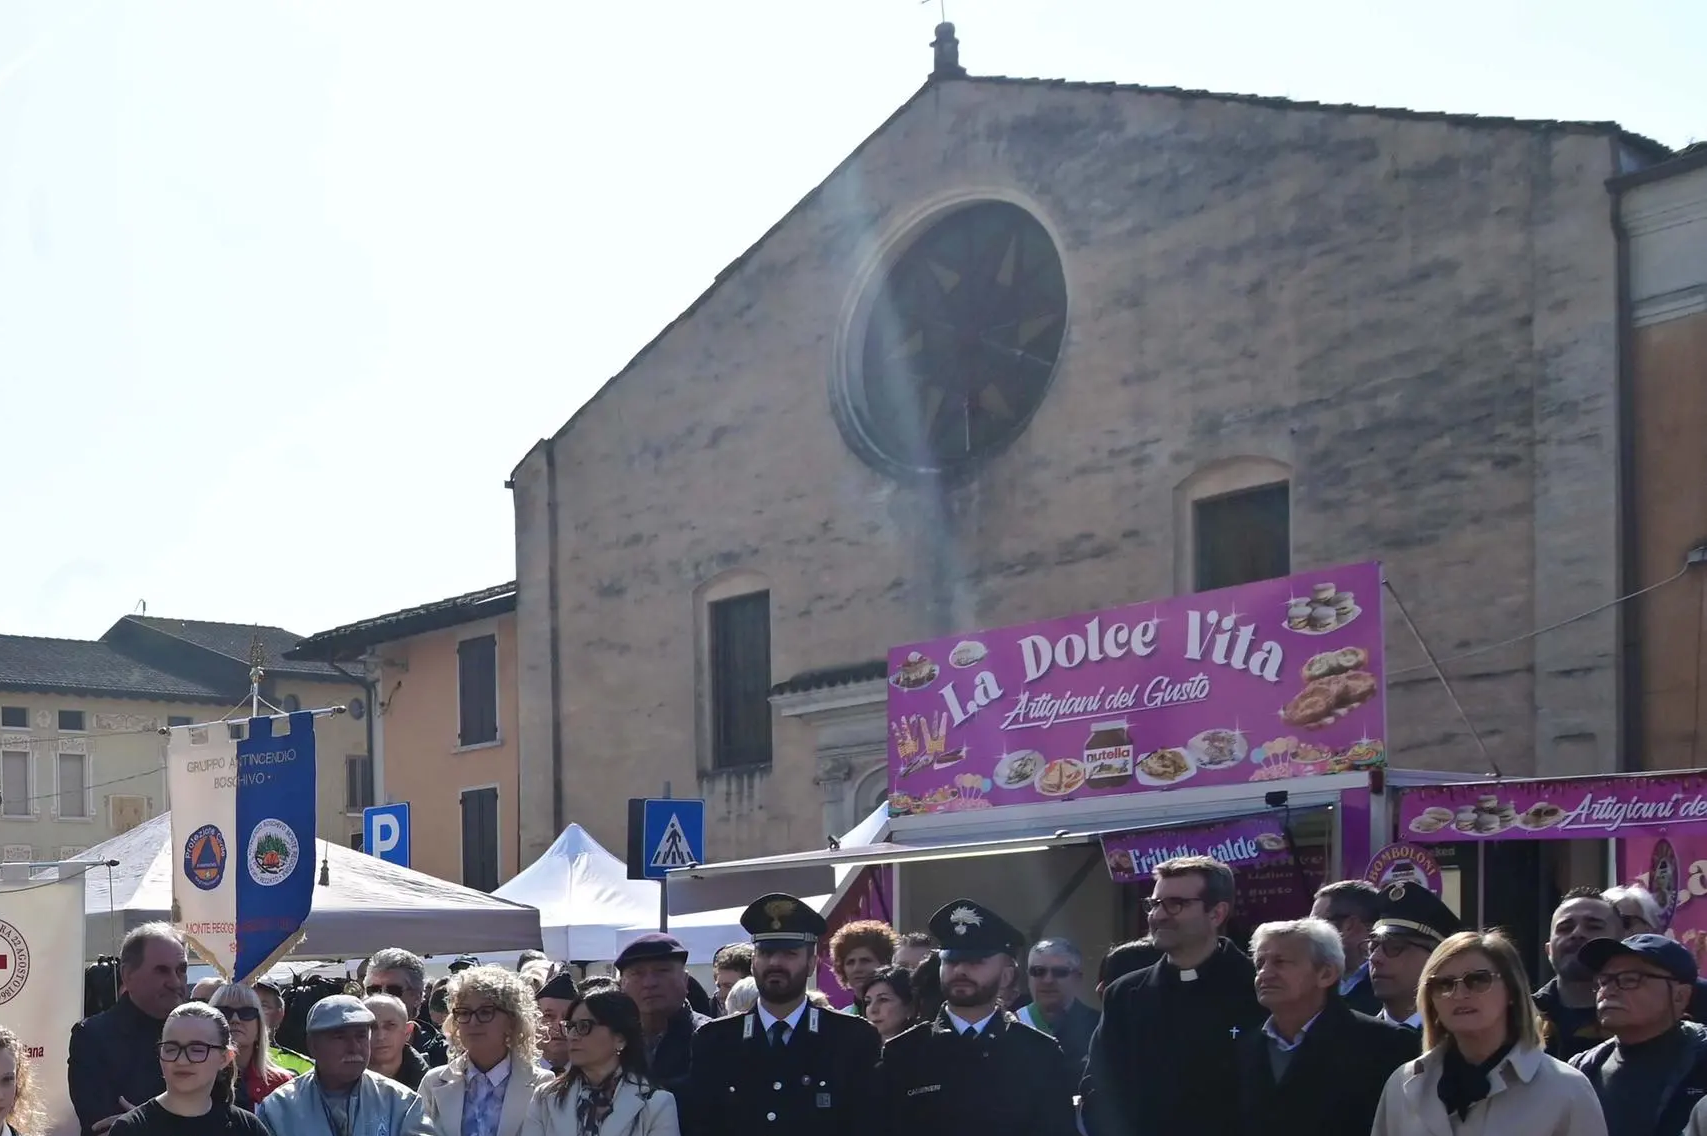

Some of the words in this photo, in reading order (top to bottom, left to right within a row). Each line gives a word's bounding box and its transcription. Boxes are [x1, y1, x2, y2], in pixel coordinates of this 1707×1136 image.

[938, 669, 1005, 728] La
[1016, 615, 1159, 684] Dolce
[1184, 609, 1285, 682] Vita
[1000, 686, 1105, 729] Artigiani
[1105, 685, 1139, 707] del
[1143, 672, 1211, 707] Gusto
[186, 757, 226, 773] GRUPPO
[1087, 747, 1130, 763] nutella
[213, 772, 266, 789] BOSCHIVO
[1557, 792, 1677, 831] Artigiani
[373, 813, 400, 860] P
[1368, 845, 1437, 882] BOMBOLONI
[10, 935, 22, 947] 22
[12, 946, 28, 989] AGOSTO
